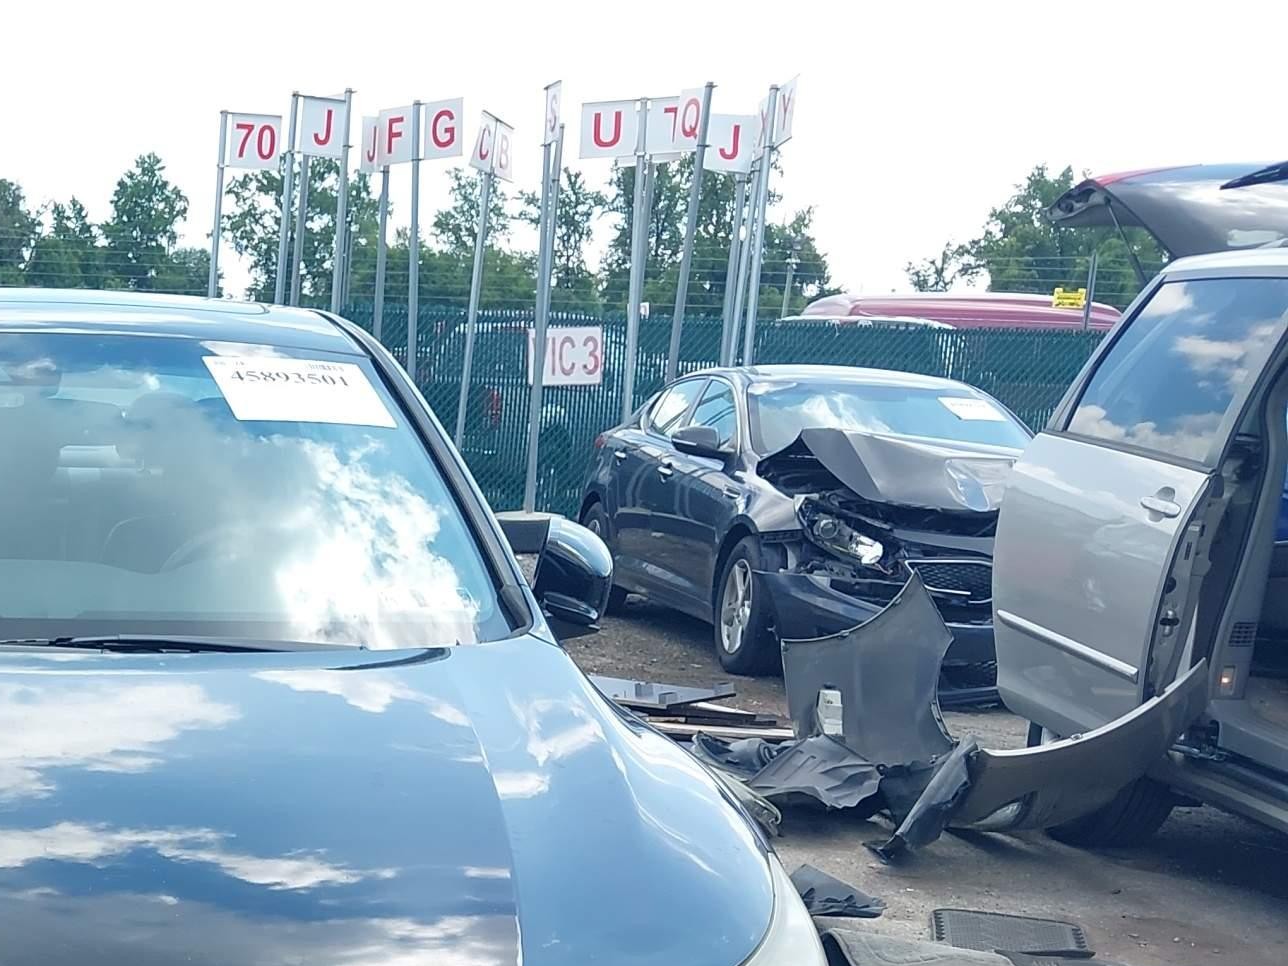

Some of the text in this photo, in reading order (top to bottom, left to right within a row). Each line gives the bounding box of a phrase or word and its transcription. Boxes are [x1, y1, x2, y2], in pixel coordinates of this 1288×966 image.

[313, 109, 334, 147] J
[387, 116, 404, 154] F
[431, 109, 456, 149] G
[593, 111, 622, 148] U
[681, 97, 701, 140] Q
[235, 123, 276, 160] 70
[479, 124, 491, 160] C
[718, 124, 741, 160] J
[582, 335, 600, 375] 3
